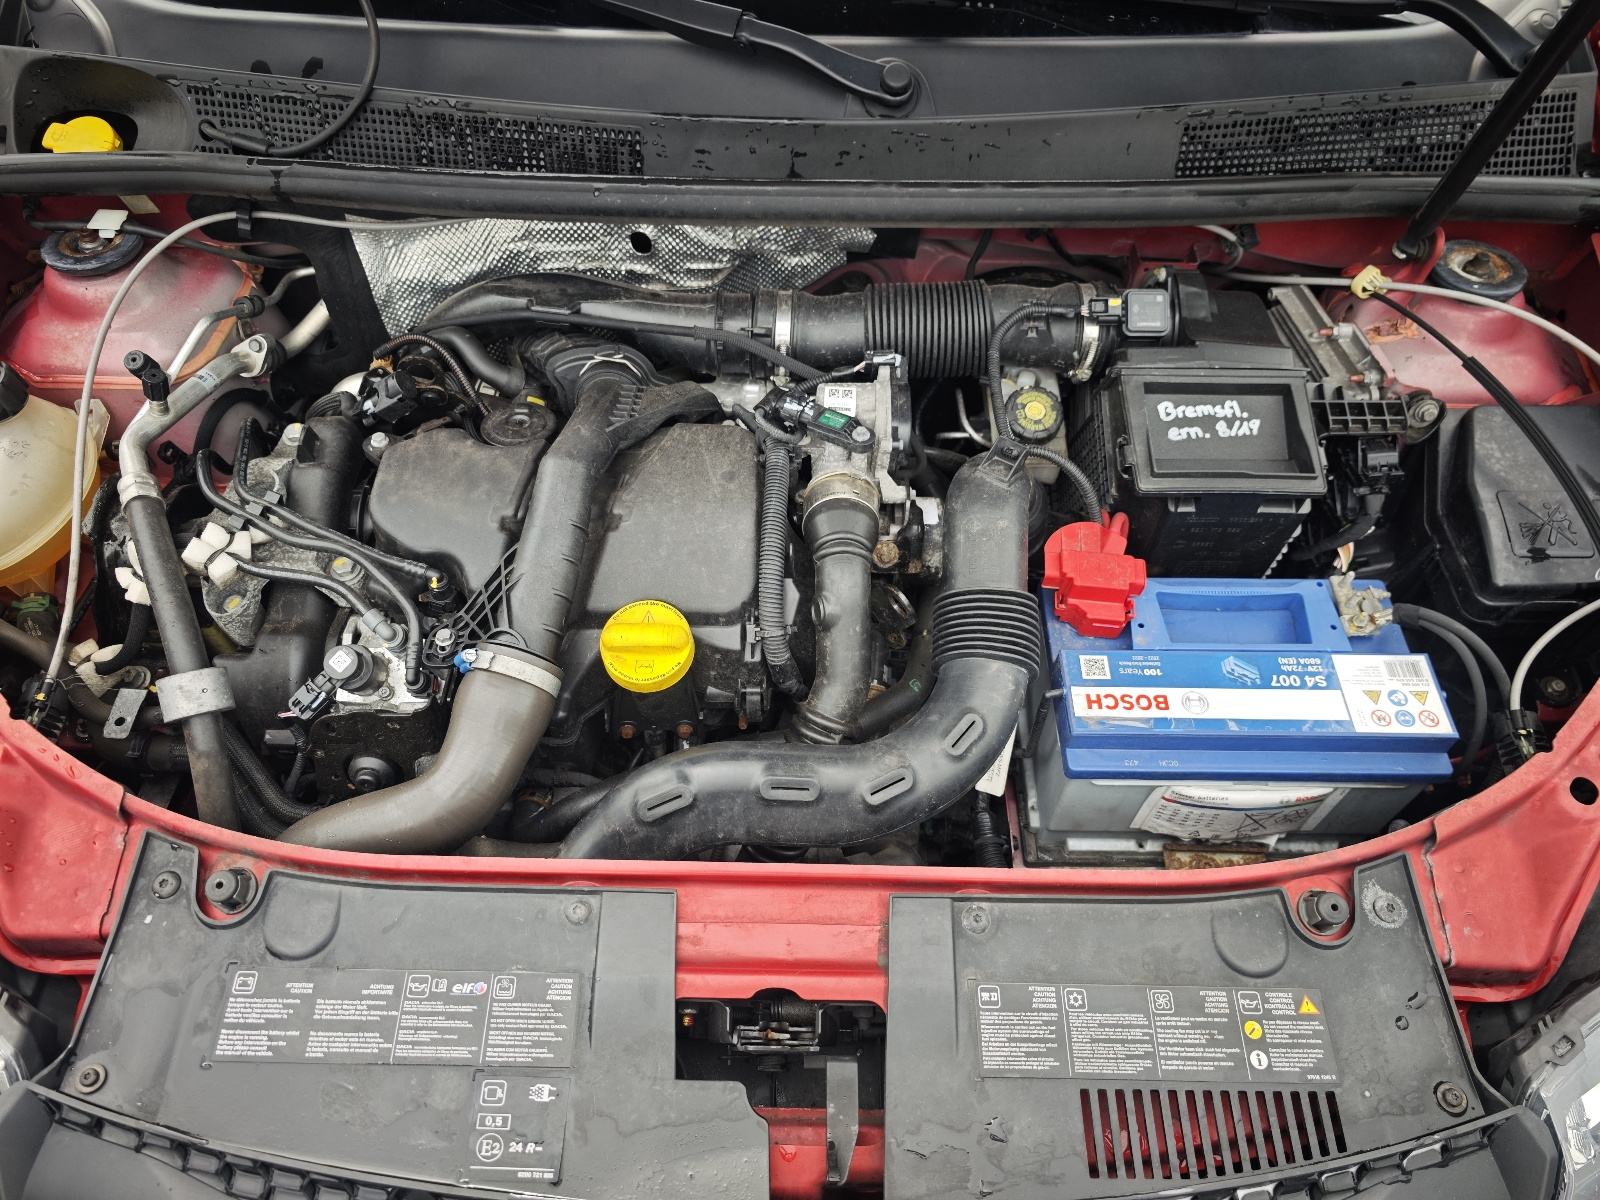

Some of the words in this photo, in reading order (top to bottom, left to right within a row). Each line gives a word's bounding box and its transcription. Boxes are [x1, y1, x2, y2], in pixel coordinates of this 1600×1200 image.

[1215, 419, 1261, 437] 8/19
[1278, 656, 1297, 664] (EN)
[1118, 668, 1144, 676] Years
[1271, 674, 1301, 686] 007
[1304, 675, 1328, 688] S4
[1085, 694, 1170, 711] BOSCH
[452, 982, 475, 994] elf
[485, 1116, 502, 1127] 0,5
[480, 1140, 500, 1156] E2
[508, 1142, 523, 1152] 24
